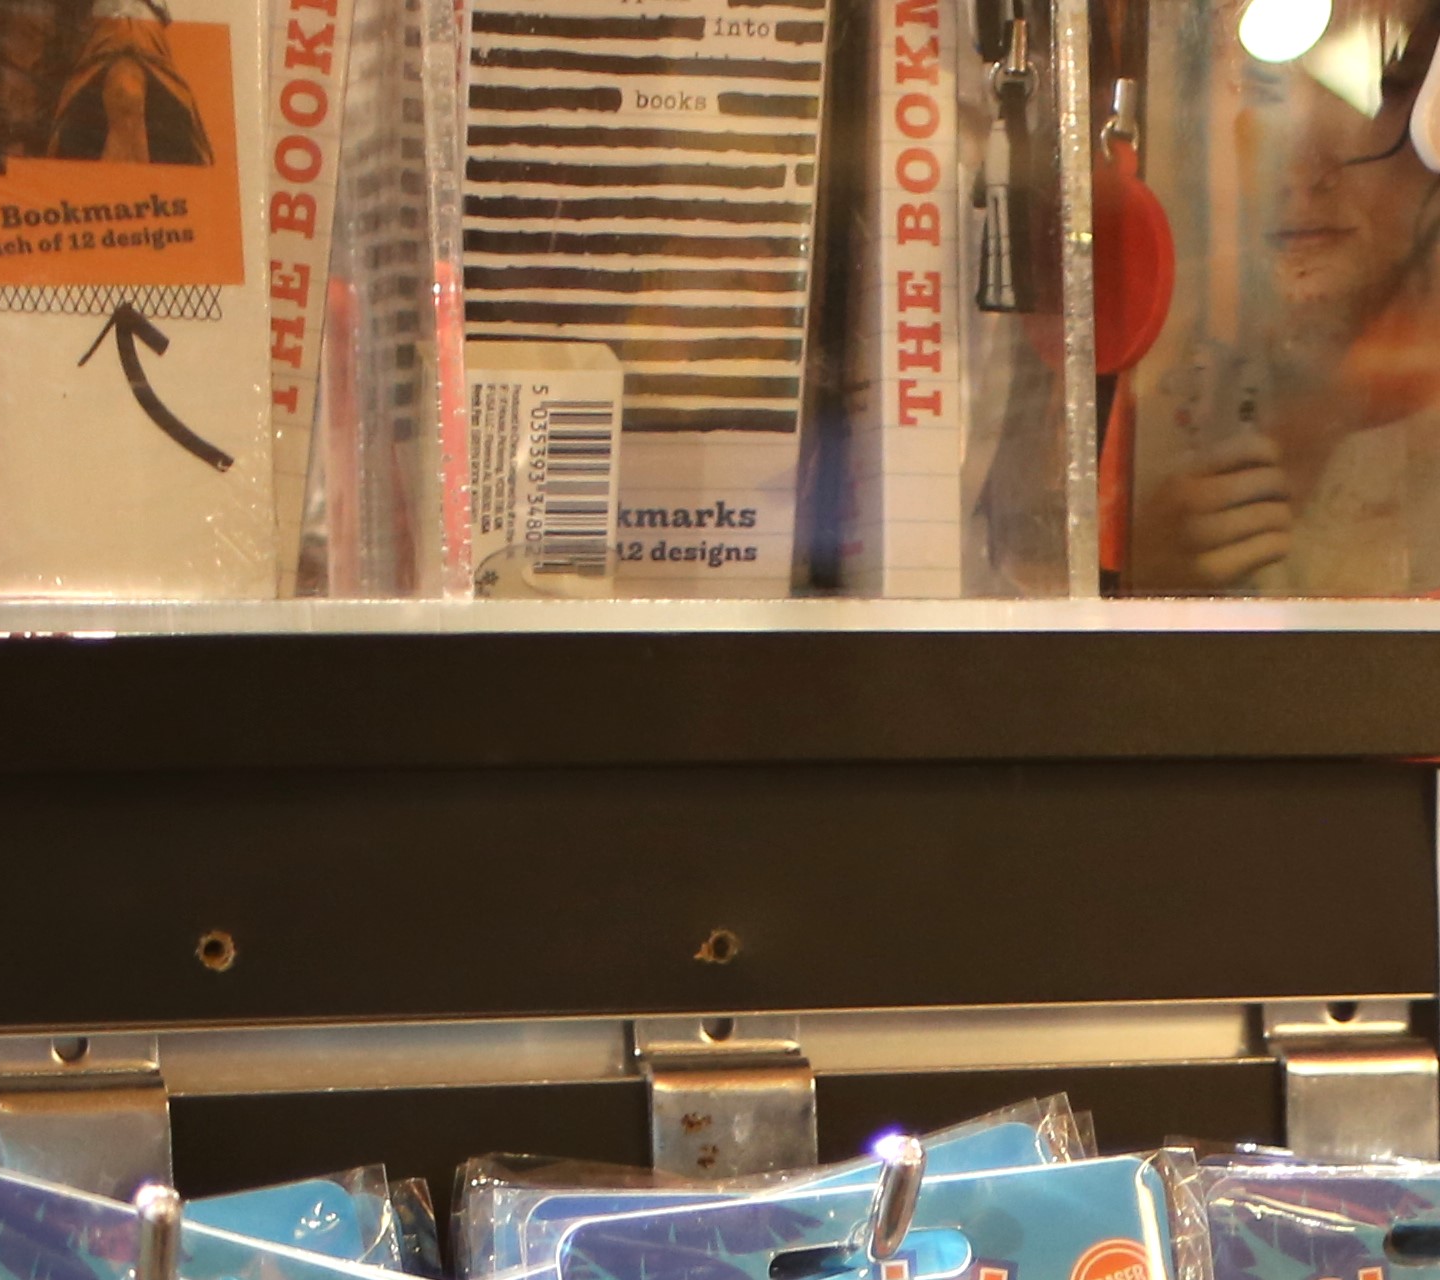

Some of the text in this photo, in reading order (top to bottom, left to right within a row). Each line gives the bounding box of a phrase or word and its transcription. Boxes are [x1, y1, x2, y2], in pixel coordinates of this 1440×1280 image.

[713, 17, 770, 38] into
[635, 89, 708, 111] books
[0, 193, 188, 231] Bookmarks
[38, 233, 64, 253] of
[68, 231, 96, 251] 12
[100, 225, 194, 252] designs
[897, 270, 942, 428] THE
[528, 408, 548, 483] 035393
[617, 500, 758, 529] kmarks
[649, 540, 758, 568] designs
